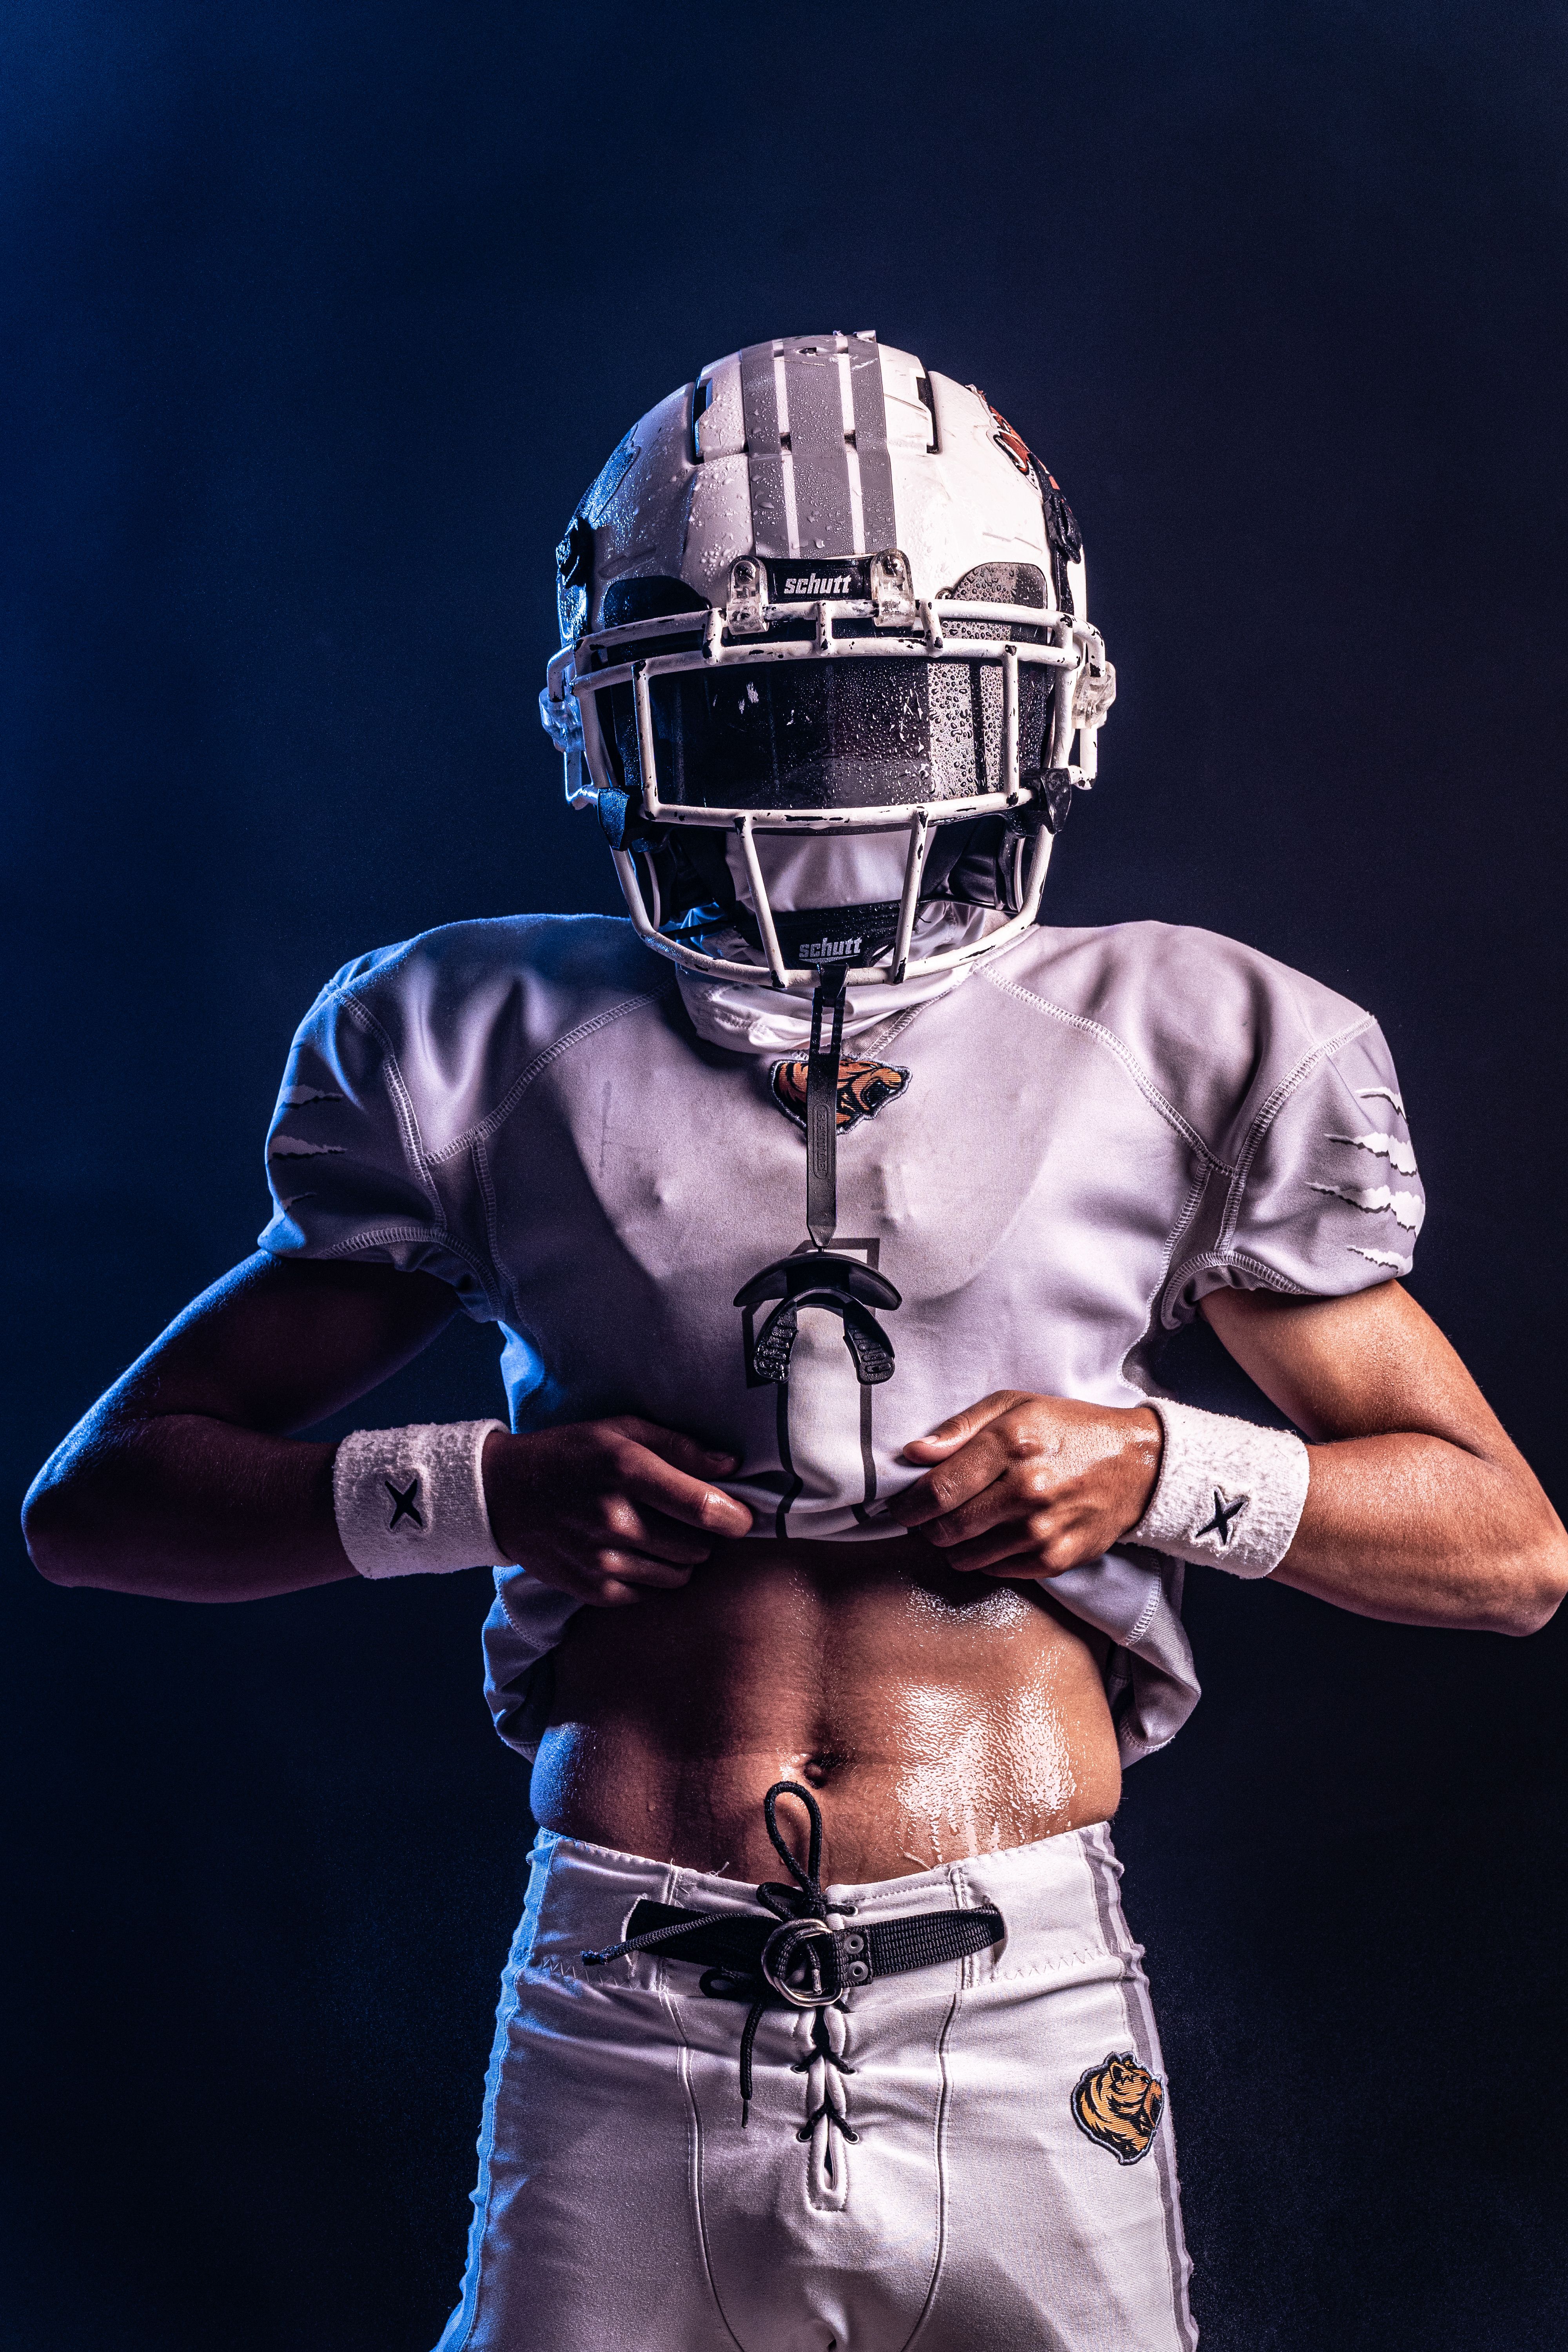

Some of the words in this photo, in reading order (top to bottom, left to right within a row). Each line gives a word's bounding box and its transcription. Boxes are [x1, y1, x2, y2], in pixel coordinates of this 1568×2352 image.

[784, 573, 851, 594] schutt
[799, 937, 862, 958] schutt
[817, 1111, 827, 1171] BATTLE
